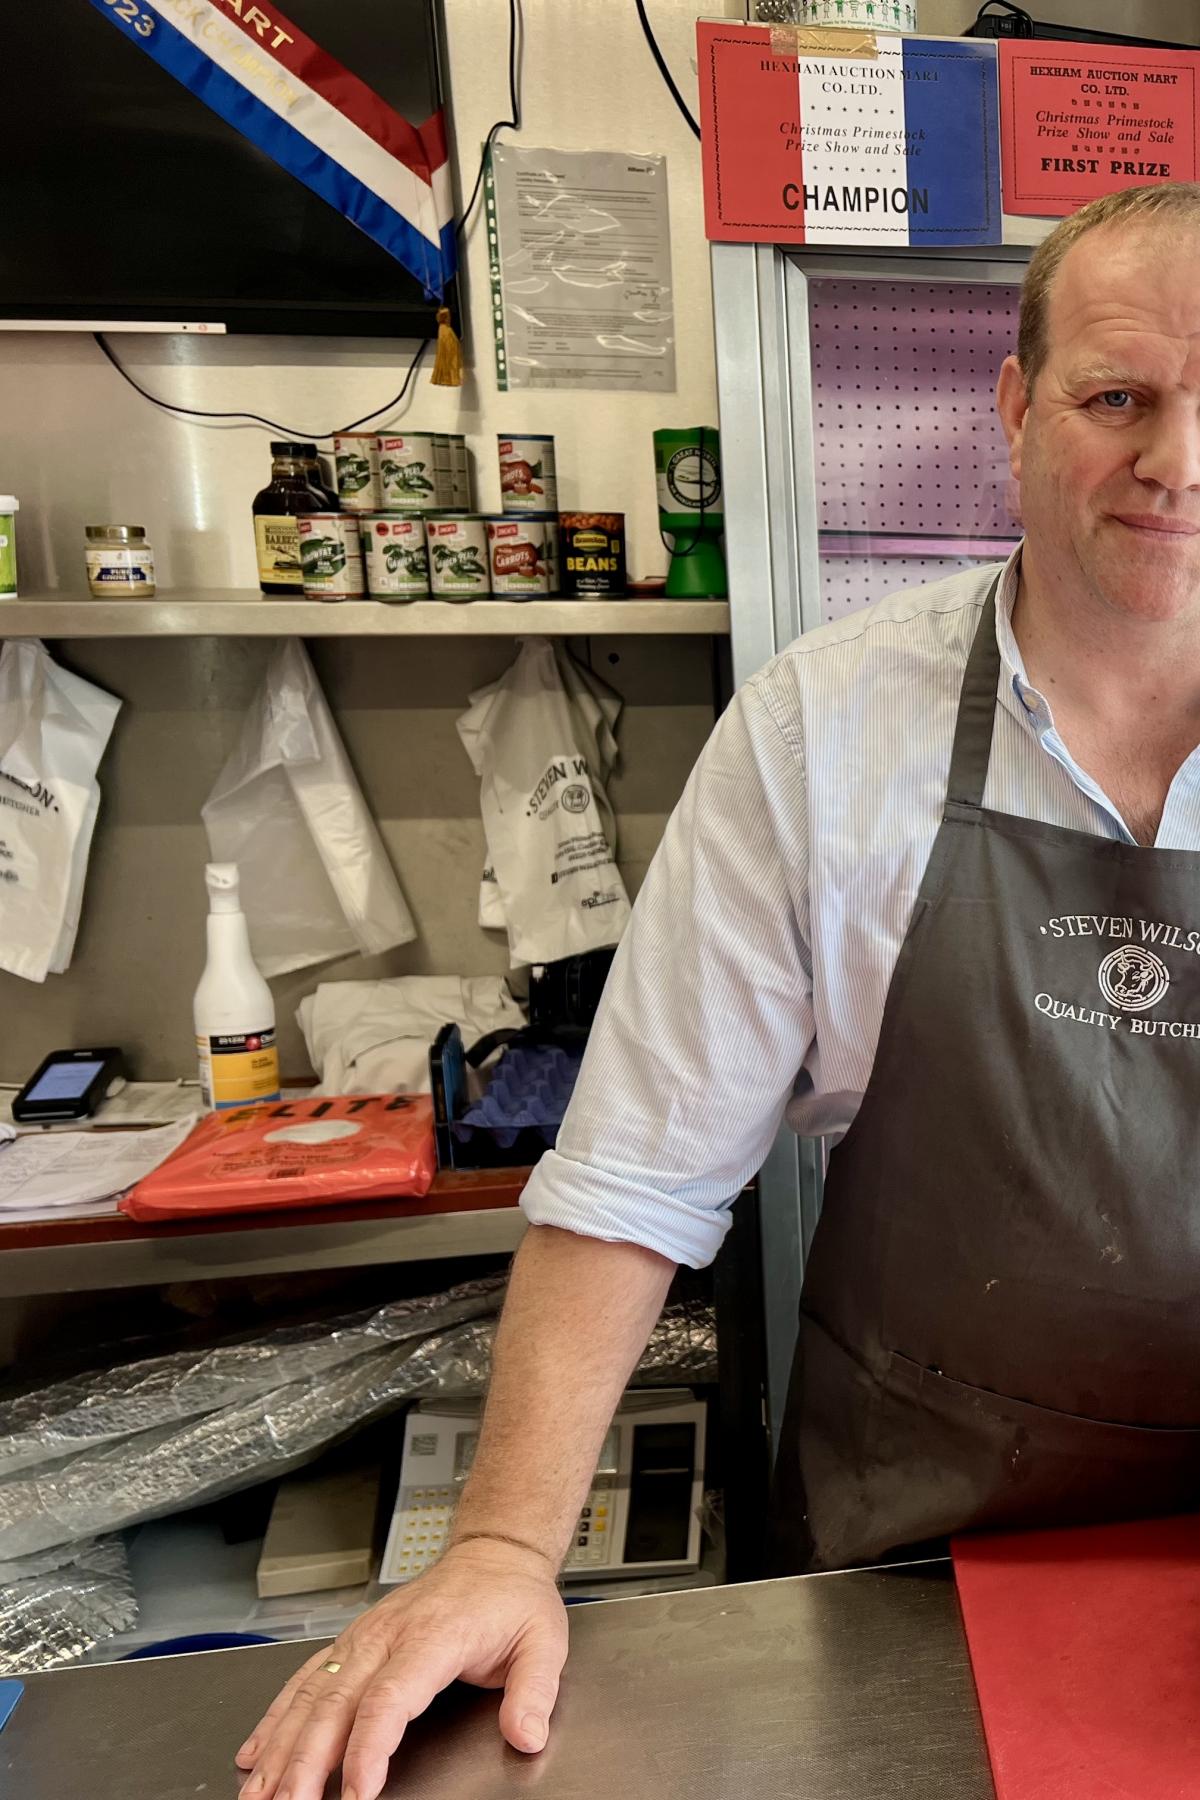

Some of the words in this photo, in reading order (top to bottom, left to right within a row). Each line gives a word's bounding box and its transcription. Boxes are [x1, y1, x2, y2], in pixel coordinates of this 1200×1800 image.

[106, 0, 156, 37] 23
[220, 0, 294, 49] ART
[202, 20, 303, 109] CHAMPION
[760, 60, 826, 76] HEXHAM
[828, 64, 896, 80] AUCTION
[899, 69, 941, 82] MART
[1030, 66, 1082, 79] HEXHAM
[1086, 69, 1139, 83] AUCTION
[1143, 73, 1178, 85] MART
[821, 81, 848, 94] CO.
[850, 82, 883, 96] LTD.
[1080, 83, 1101, 95] CO.
[1105, 85, 1130, 97] LTD.
[1035, 110, 1100, 126] Christmas
[1106, 114, 1174, 129] Primestock
[779, 122, 848, 138] Christmas
[852, 125, 927, 141] Primestock
[1036, 125, 1069, 139] Prize
[1076, 127, 1111, 140] Show
[1117, 130, 1141, 142] and
[1147, 131, 1175, 144] Sale
[785, 139, 820, 153] Prize
[824, 140, 861, 154] Show
[864, 142, 890, 156] and
[894, 143, 922, 157] Sale
[1040, 157, 1100, 174] FIRST
[1110, 160, 1171, 177] PRIZE
[782, 183, 930, 214] CHAMPION
[265, 534, 299, 545] BARBEC
[496, 551, 530, 567] CARROTS
[566, 557, 618, 572] BEANS
[528, 762, 567, 815] STEVEN
[1049, 915, 1133, 938] STEVEN
[1034, 993, 1122, 1031] QUALITY
[224, 1096, 420, 1124] ELITE
